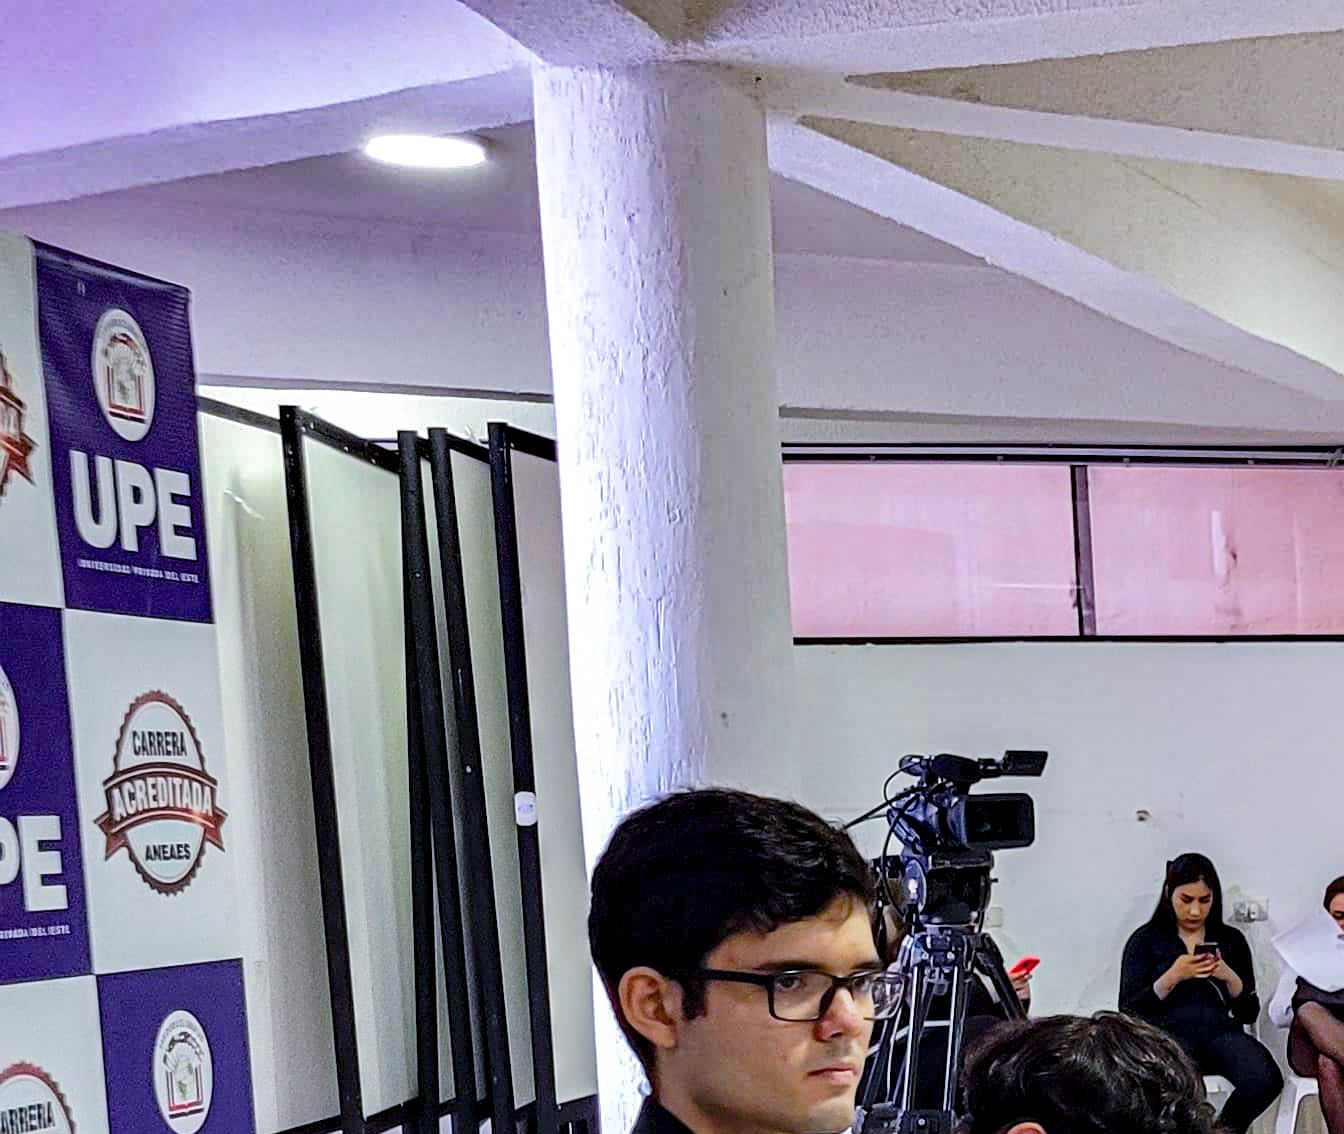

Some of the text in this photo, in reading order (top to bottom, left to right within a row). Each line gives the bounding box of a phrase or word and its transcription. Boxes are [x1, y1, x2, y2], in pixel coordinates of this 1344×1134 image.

[69, 449, 198, 561] UPE
[131, 730, 188, 757] CARRERA
[110, 776, 214, 822] ACREDITADA
[144, 843, 191, 862] ANEAES
